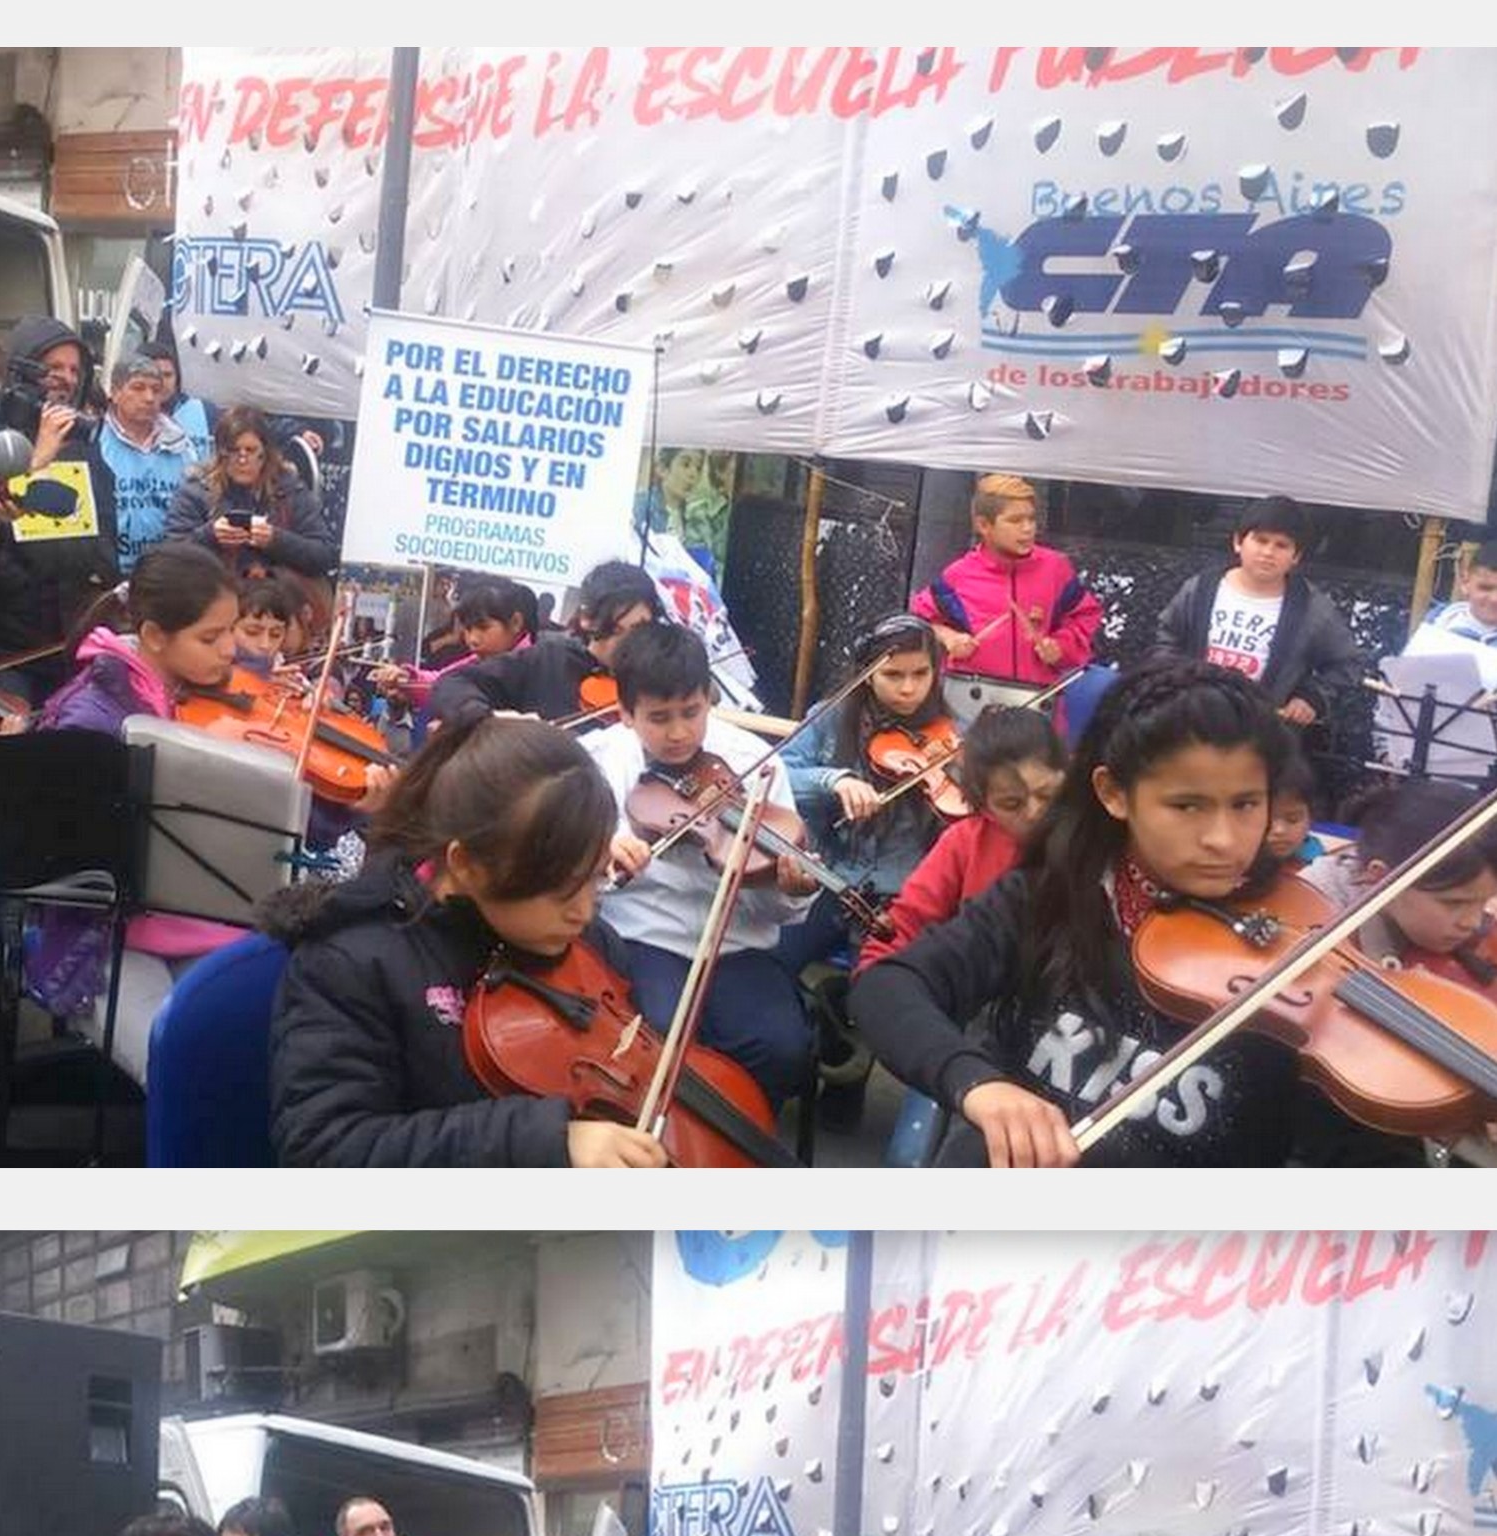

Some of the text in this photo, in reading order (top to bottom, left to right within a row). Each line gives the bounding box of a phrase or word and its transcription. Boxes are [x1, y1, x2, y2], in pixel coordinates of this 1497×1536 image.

[533, 47, 611, 139] LA
[1031, 172, 1405, 219] Buenos Aires
[1001, 213, 1394, 319] CTA
[383, 373, 403, 400] A
[413, 378, 449, 406] LA
[385, 340, 632, 396] POR EL DERECHO
[987, 364, 1350, 402] de los trabajdores
[394, 408, 605, 459] POR SALARIOS
[404, 443, 586, 489] DIGNOS Y EN
[395, 534, 569, 574] SOCIOEDUCATIVOS
[424, 514, 546, 547] PROGRAMAS
[1102, 1230, 1437, 1332] ESCUELA
